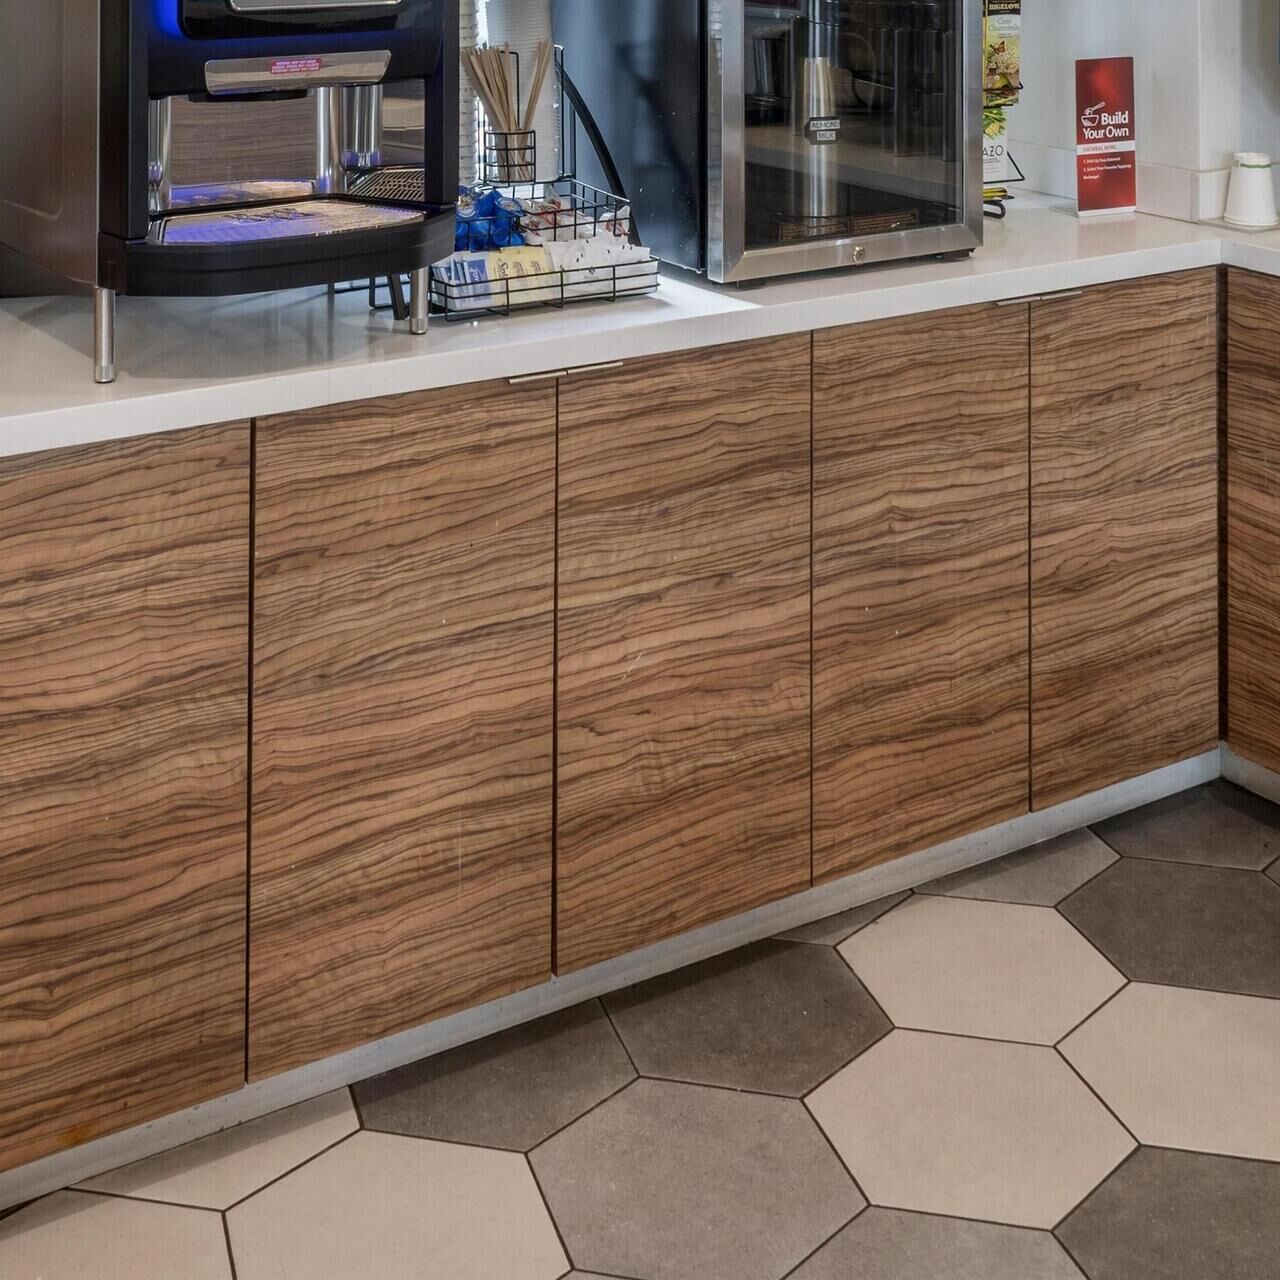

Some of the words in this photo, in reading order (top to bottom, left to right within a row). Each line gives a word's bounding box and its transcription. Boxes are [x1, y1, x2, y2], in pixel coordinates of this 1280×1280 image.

[988, 3, 1020, 11] BIGELOW
[1101, 110, 1129, 126] Build
[1083, 127, 1106, 140] Your
[1106, 126, 1129, 138] Own
[983, 145, 1004, 157] AZO
